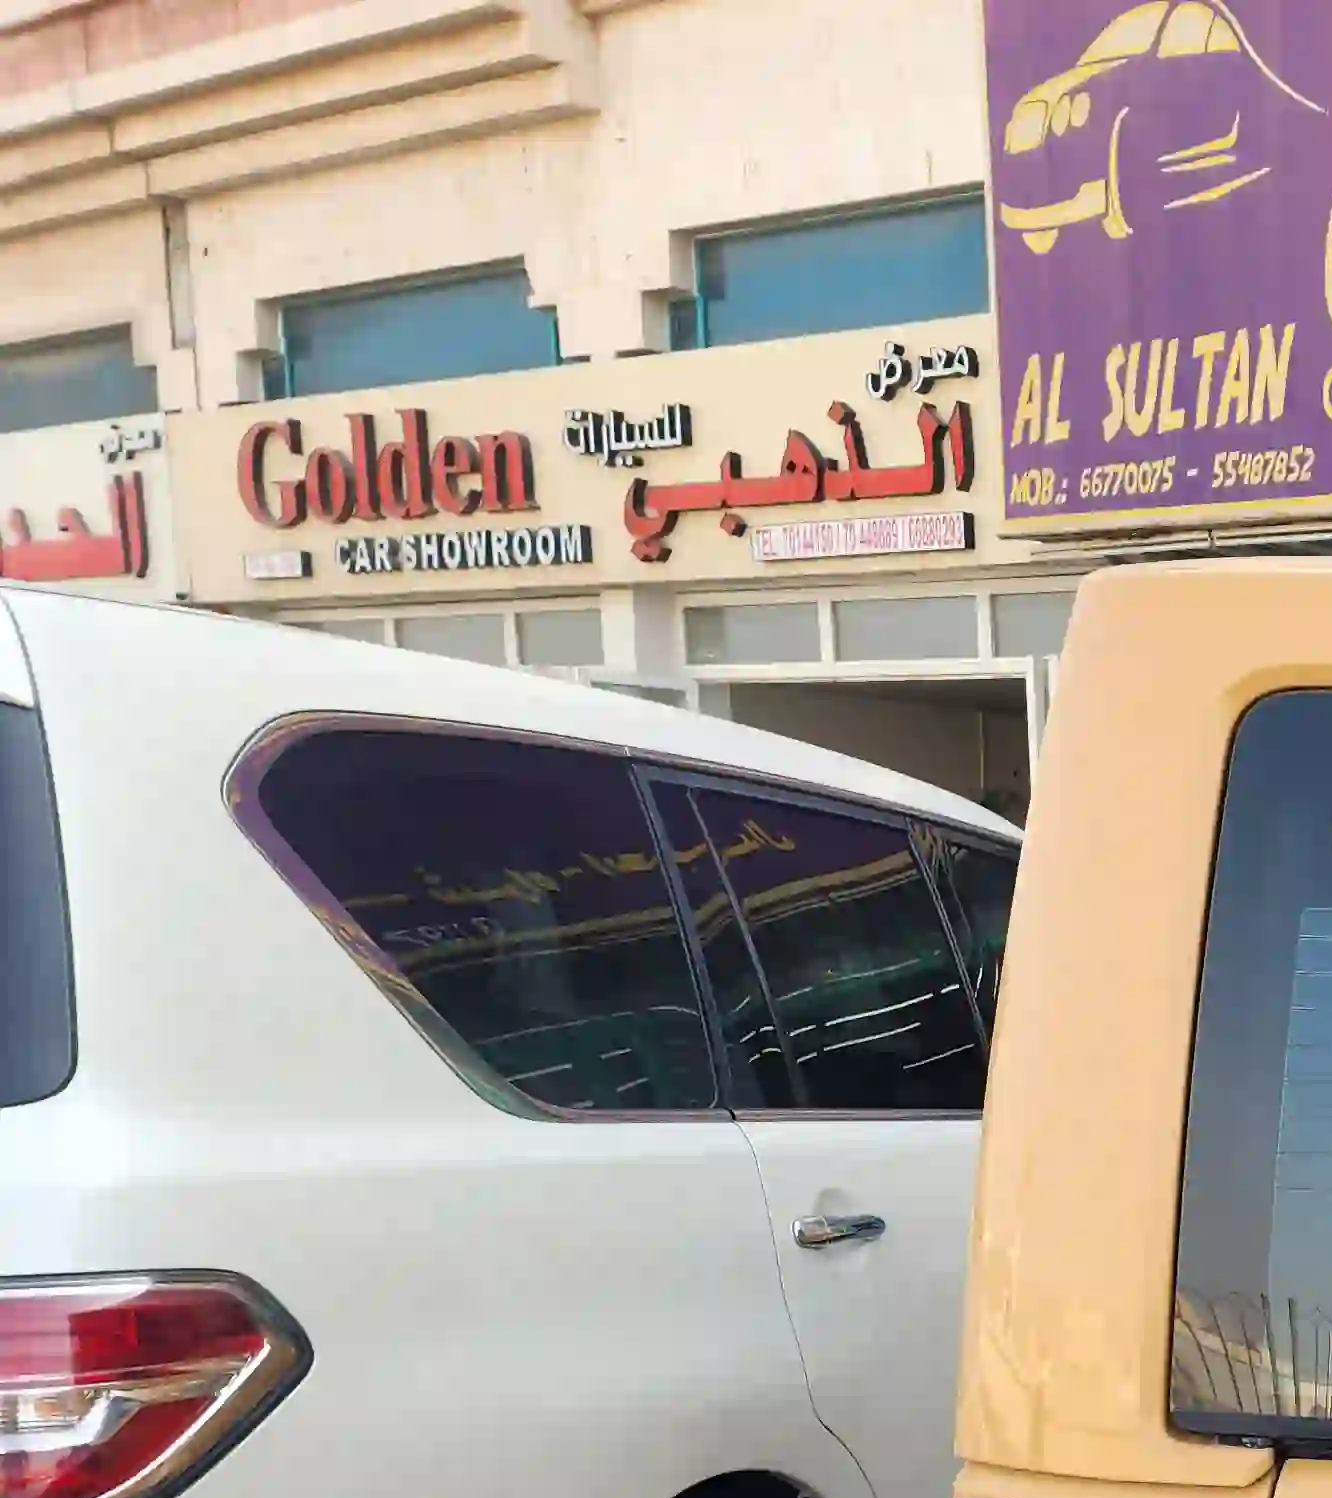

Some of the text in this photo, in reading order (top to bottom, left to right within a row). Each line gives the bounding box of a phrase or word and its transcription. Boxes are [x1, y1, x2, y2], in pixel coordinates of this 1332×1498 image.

[866, 341, 979, 401] معرض
[1010, 352, 1071, 448] AL
[1102, 323, 1297, 443] SULTAN
[237, 408, 541, 529] Golden
[563, 403, 694, 468] للسيارات
[623, 400, 975, 564] الذهبي
[334, 536, 400, 575] CAR
[400, 525, 592, 573] SHOWROOM
